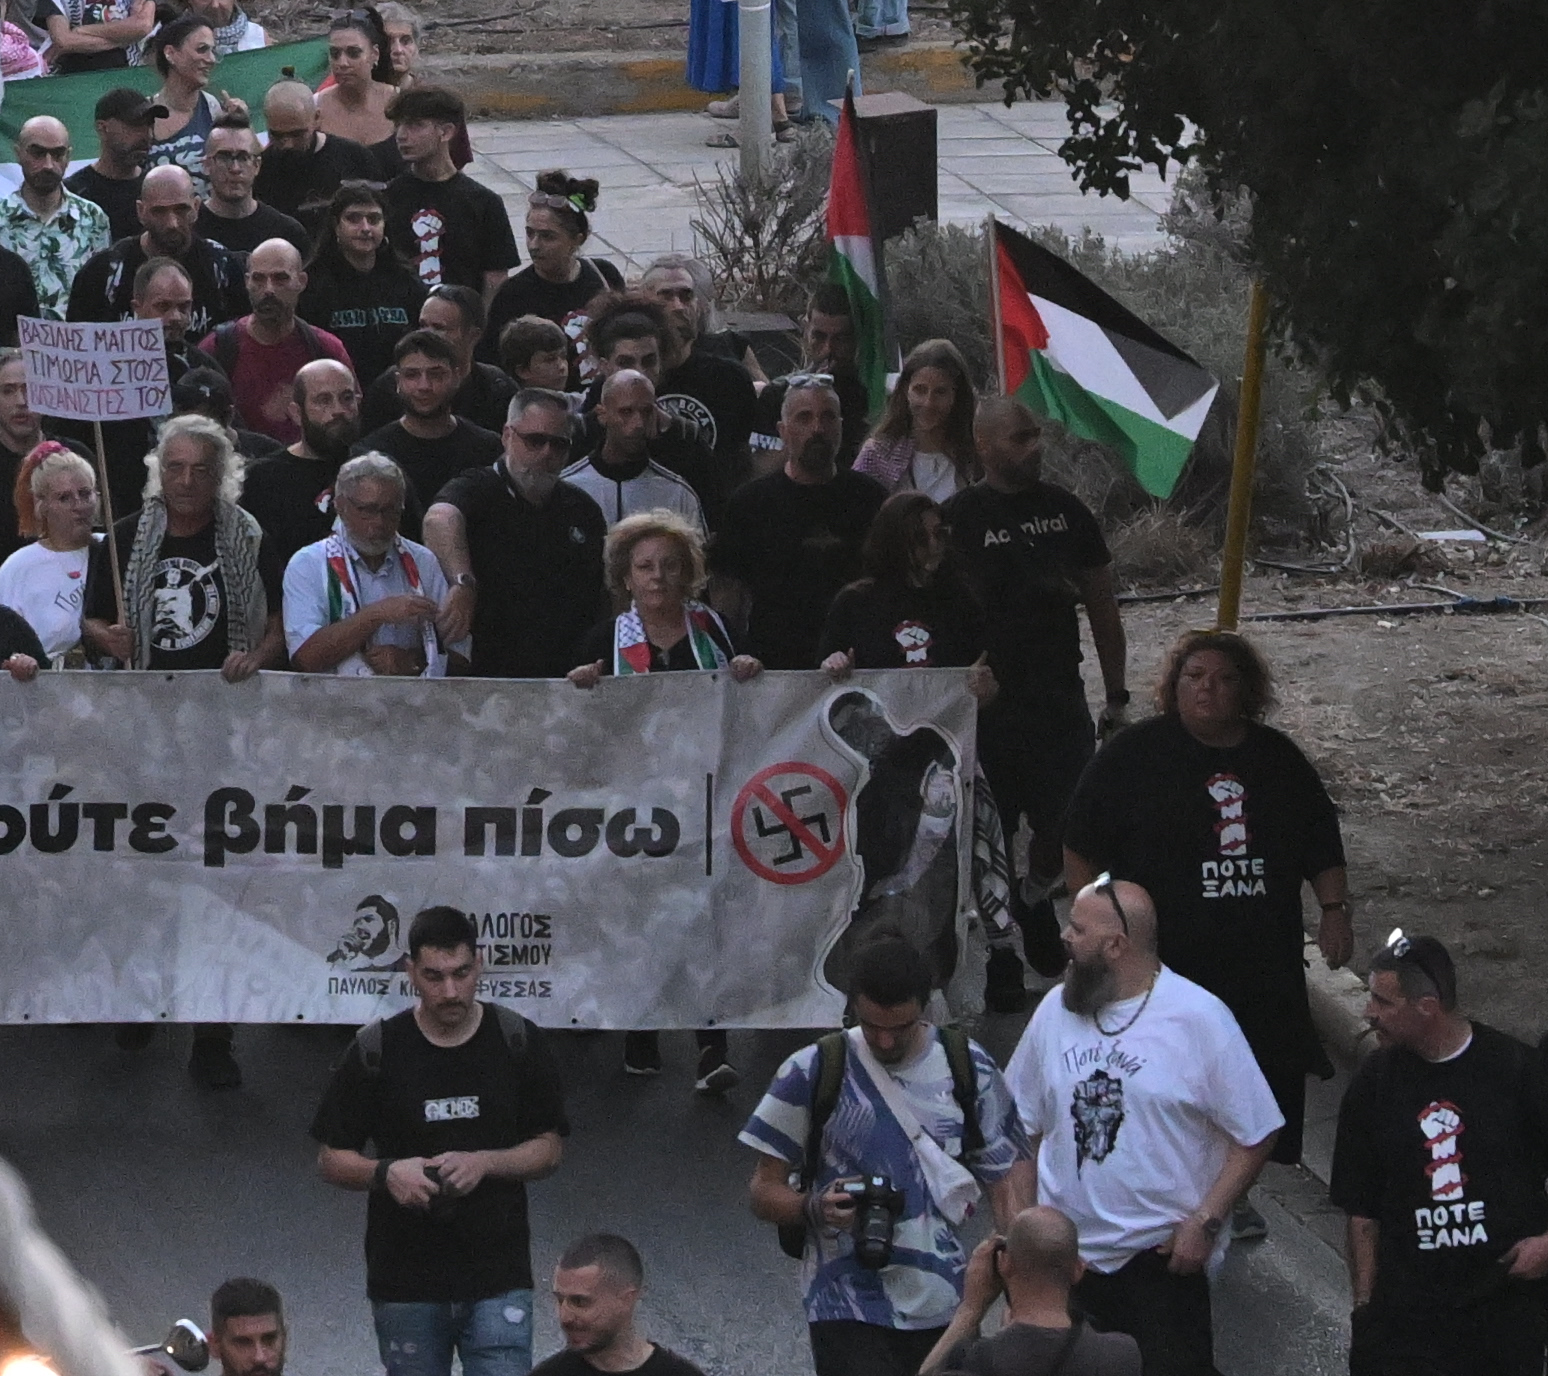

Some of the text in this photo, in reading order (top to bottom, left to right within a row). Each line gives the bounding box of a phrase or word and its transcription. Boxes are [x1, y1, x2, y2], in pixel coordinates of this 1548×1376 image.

[20, 319, 162, 352] ΒΑΣΙΛΗΣ ΜΑΓΓΟΣ
[24, 349, 168, 385] ΤΙΜΩΡΙΑ ΣΤΟΥΣ
[135, 384, 169, 411] ΤΟΥ
[202, 782, 437, 869] βήμα
[463, 783, 681, 859] πίσω
[1201, 859, 1264, 878] ΠΟΤΕ
[1201, 879, 1267, 898] ΞΑΝΑ
[328, 978, 392, 995] ΠΑΥΛΟΣ
[1063, 1039, 1147, 1078] Ποτέ ξανά
[1415, 1201, 1486, 1227] ΠΟΤΕ
[1417, 1223, 1489, 1250] ΞΑΝΑ
